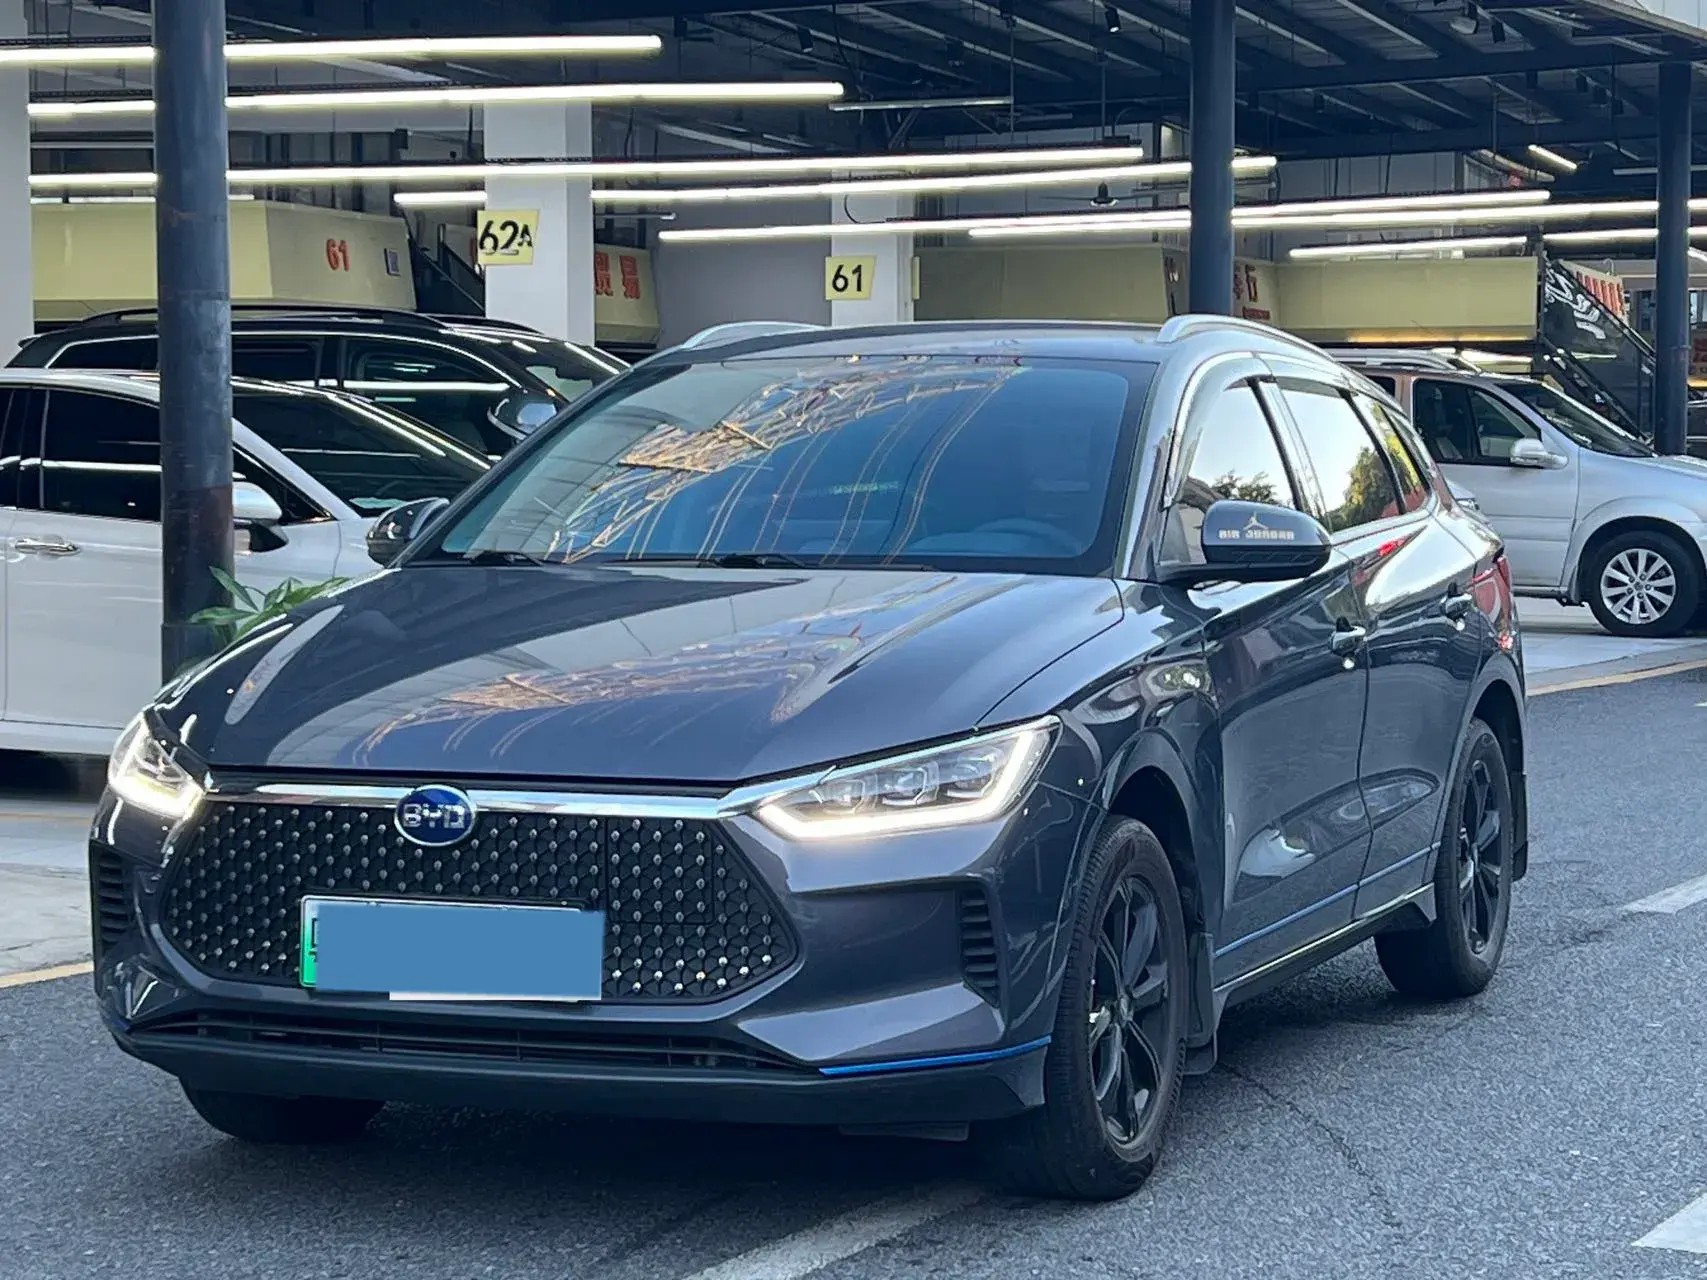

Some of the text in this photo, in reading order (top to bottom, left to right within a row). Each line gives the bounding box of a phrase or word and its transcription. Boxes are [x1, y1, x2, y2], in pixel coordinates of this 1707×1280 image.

[479, 220, 533, 255] 62A
[326, 238, 350, 272] 61
[832, 264, 862, 292] 61
[403, 803, 465, 828] BYD
